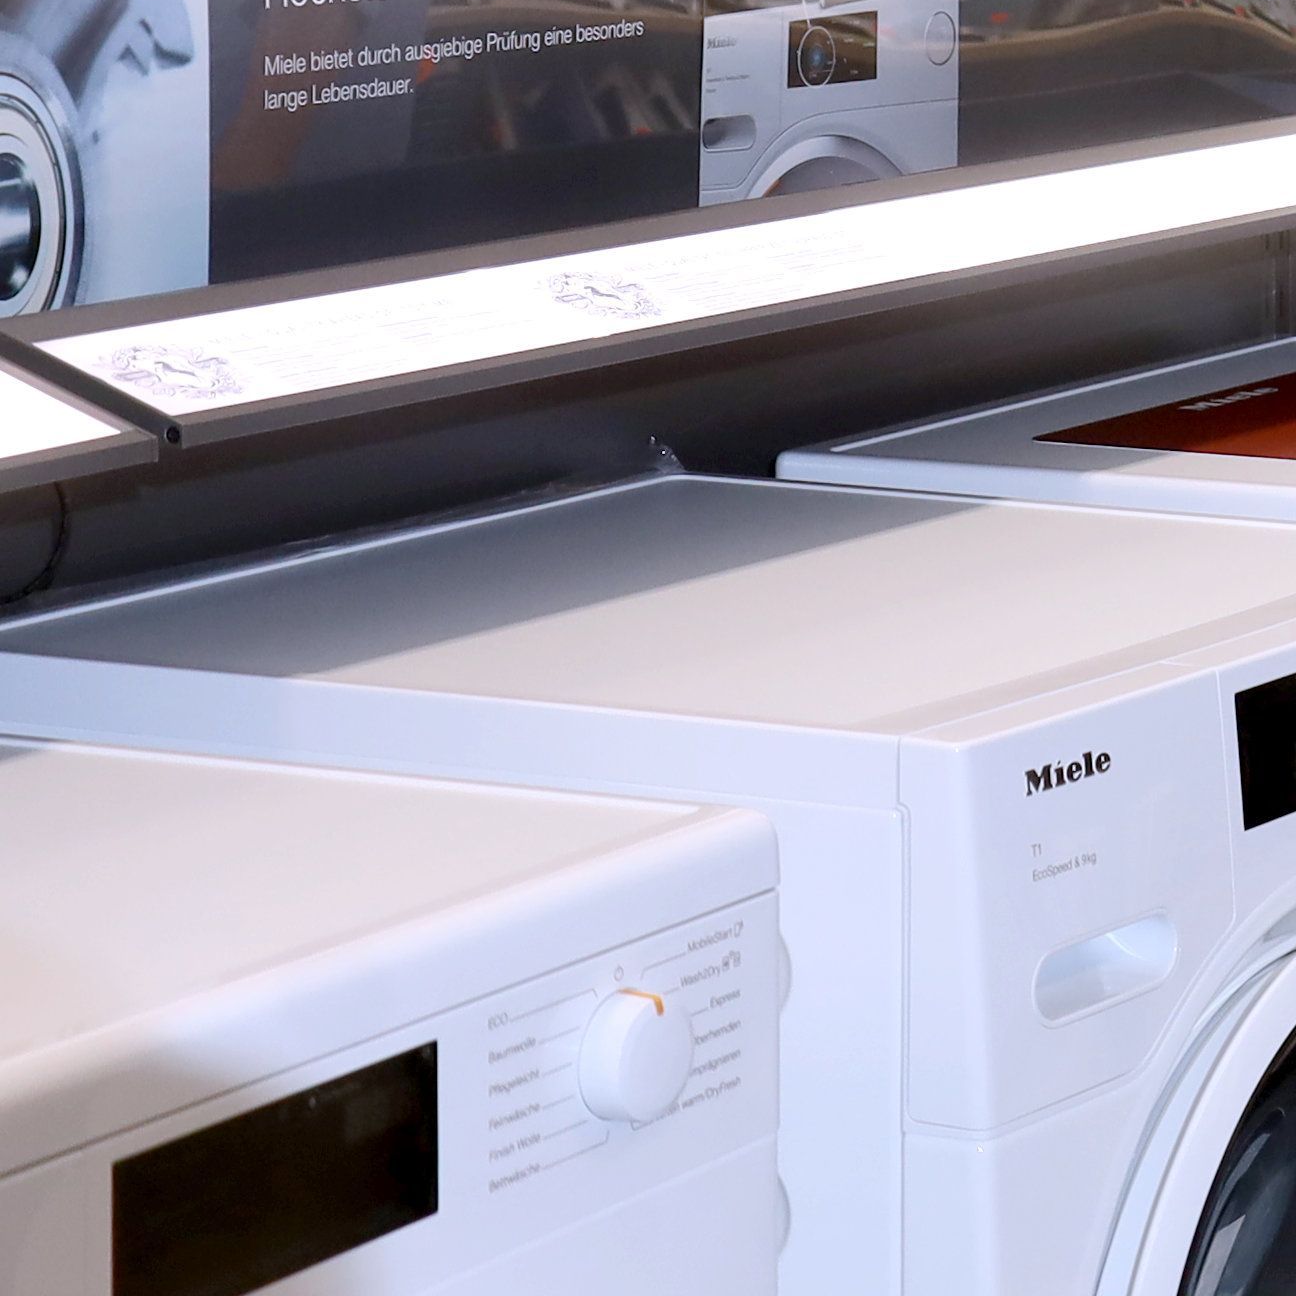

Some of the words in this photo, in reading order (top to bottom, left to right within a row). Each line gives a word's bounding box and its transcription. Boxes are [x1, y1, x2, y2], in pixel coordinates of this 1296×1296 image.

[263, 51, 307, 77] Miele
[310, 46, 355, 73] bietet
[357, 42, 402, 67] durch
[404, 36, 483, 62] ausgiebige
[486, 28, 541, 54] Prüfung
[543, 25, 573, 46] eine
[575, 18, 645, 43] besonders
[263, 88, 309, 113] lange
[312, 76, 415, 105] Lebensdauer.
[1024, 750, 1111, 797] Miele
[1030, 842, 1043, 858] T1
[1032, 858, 1074, 883] EcoSpeed
[686, 927, 733, 953] MobileStart
[680, 963, 722, 988] Wash2Dry
[708, 988, 742, 1010] Express
[487, 1012, 509, 1032] ECO
[487, 1036, 538, 1065] Baumwolle
[488, 1068, 541, 1098] Pflegeleicht
[488, 1101, 541, 1132] Feinwäsche
[488, 1142, 516, 1164] Finish
[516, 1132, 542, 1151] Wolle
[488, 1163, 541, 1195] Bettwäsche
